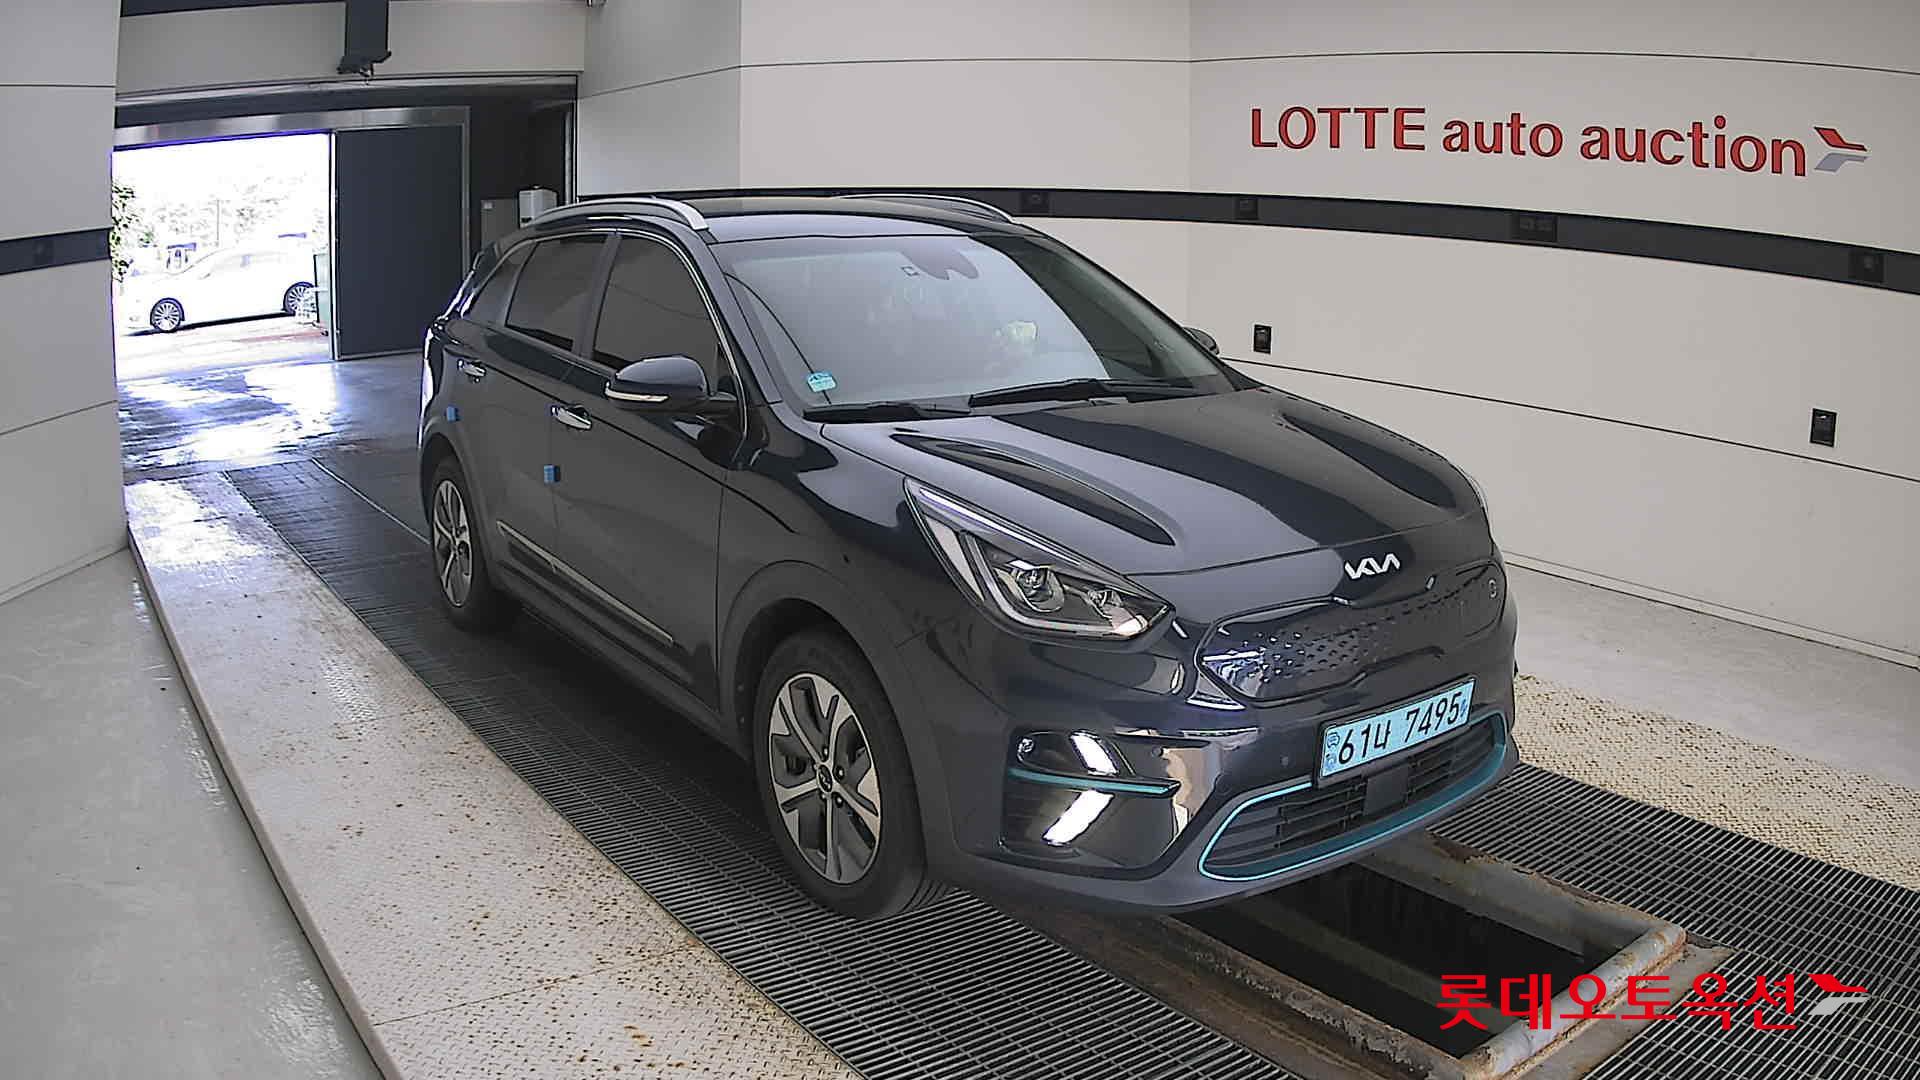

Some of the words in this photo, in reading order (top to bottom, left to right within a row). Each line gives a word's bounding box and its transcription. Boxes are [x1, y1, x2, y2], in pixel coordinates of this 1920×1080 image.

[1251, 107, 1425, 150] LOTTE
[1442, 112, 1563, 156] auto
[1580, 116, 1806, 176] auction
[1338, 719, 1391, 764] 61나
[1405, 692, 1462, 742] 7495
